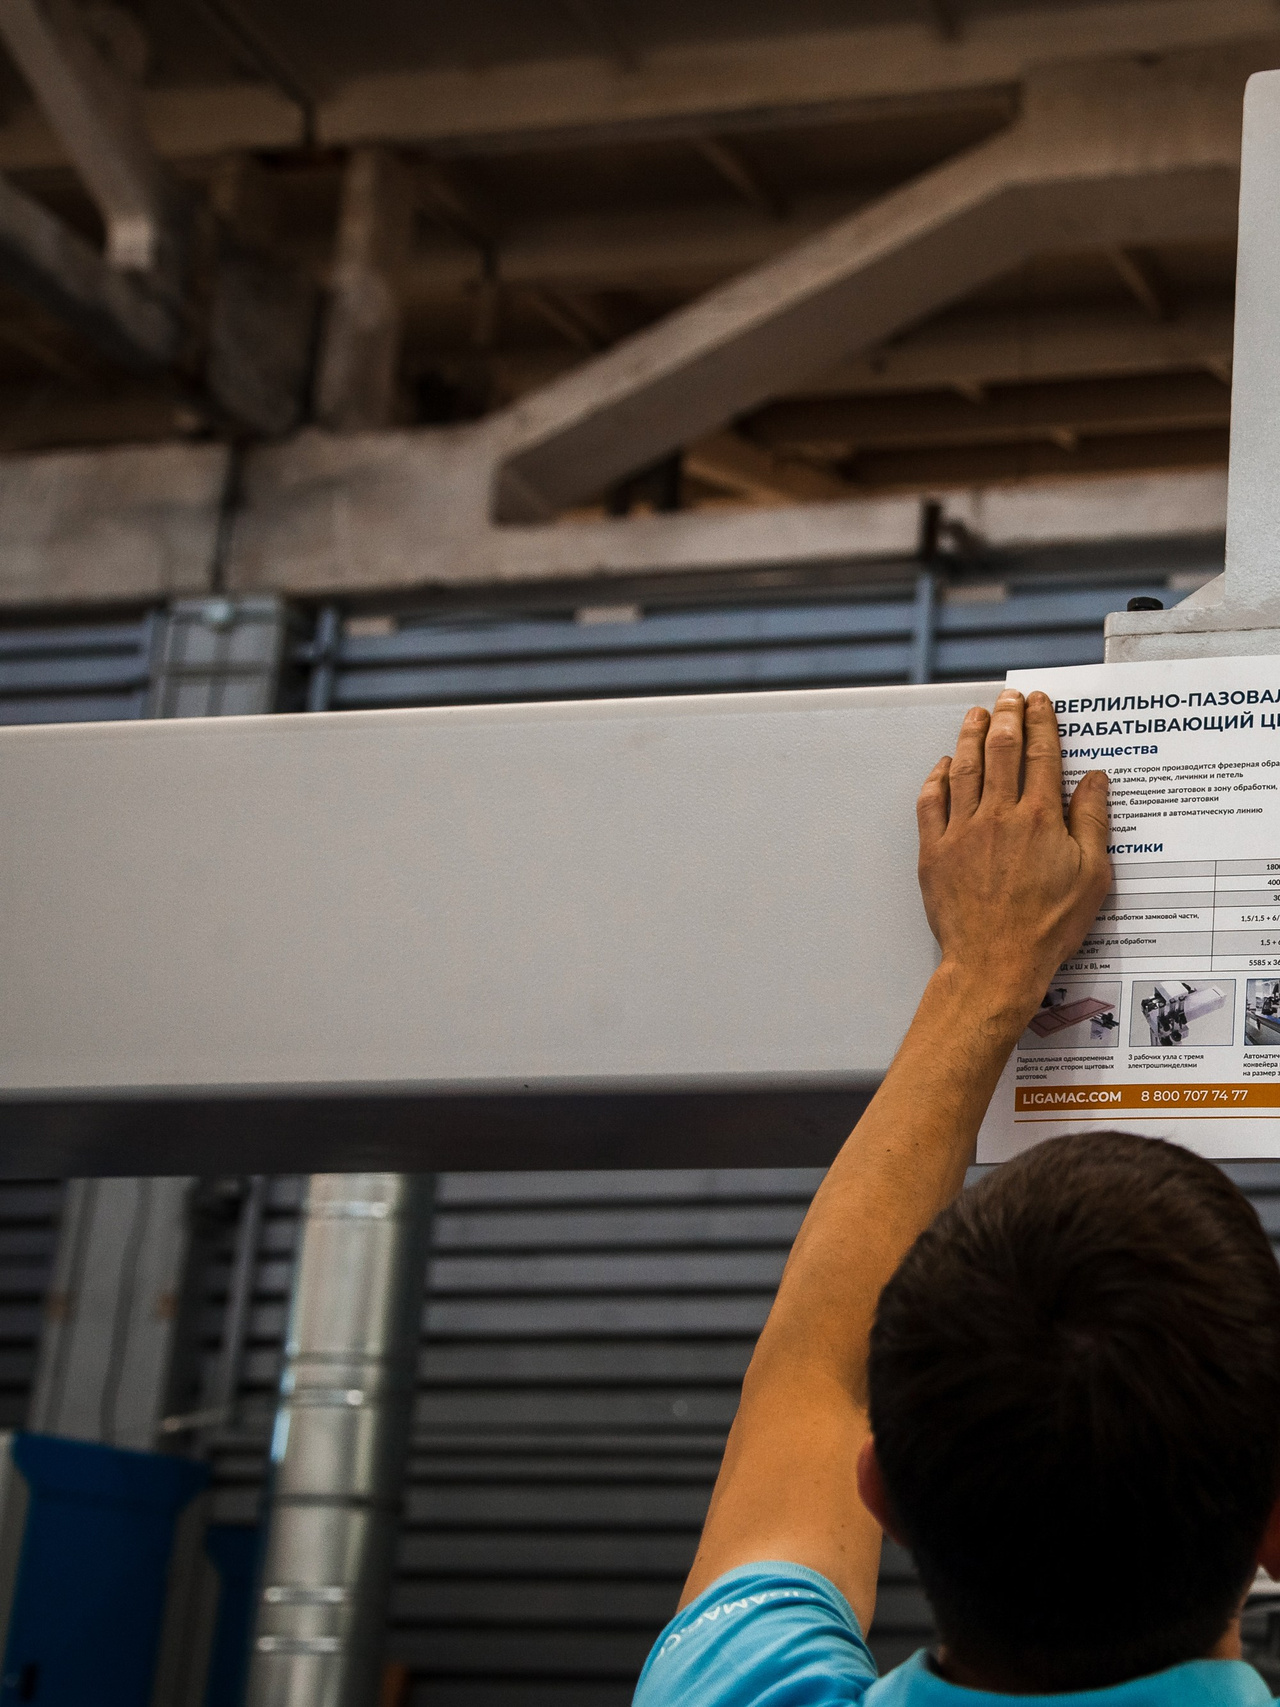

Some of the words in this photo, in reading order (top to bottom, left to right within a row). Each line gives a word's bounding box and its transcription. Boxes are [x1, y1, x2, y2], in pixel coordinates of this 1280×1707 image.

[1057, 711, 1254, 737] БРАБАТЫВАЮЩИЙ
[1061, 744, 1159, 760] еимущества
[1114, 766, 1132, 775] двух
[1133, 766, 1160, 774] сторон
[1162, 764, 1216, 772] производится
[1217, 762, 1260, 770] фрезерная
[1122, 776, 1147, 784] замка,
[1149, 775, 1173, 783] ручек,
[1112, 788, 1166, 797] перемещение
[1167, 786, 1206, 794] заготовок
[1213, 785, 1231, 793] зону
[1233, 783, 1278, 792] обработки,
[1129, 797, 1179, 806] базирование
[1113, 810, 1162, 820] встраивания
[1168, 808, 1235, 816] автоматическую
[1107, 913, 1143, 922] обработки
[1144, 912, 1178, 920] замковой
[1178, 912, 1200, 920] части,
[1119, 937, 1157, 946] обработки
[1016, 1056, 1062, 1064] Параллельная
[1063, 1055, 1114, 1063] одновременная
[1134, 1053, 1161, 1061] рабочих
[1016, 1064, 1039, 1072] работа
[1060, 1064, 1084, 1072] сторон
[1128, 1062, 1198, 1070] электрошпинделями
[1243, 1061, 1278, 1069] конвейера
[1252, 1070, 1276, 1078] размер
[1022, 1091, 1122, 1105] LIGAMAC.COM
[1141, 1090, 1150, 1102] 8
[1153, 1090, 1180, 1102] 800
[1184, 1090, 1208, 1102] 707
[1212, 1090, 1228, 1101] 74
[1231, 1090, 1248, 1101] 77
